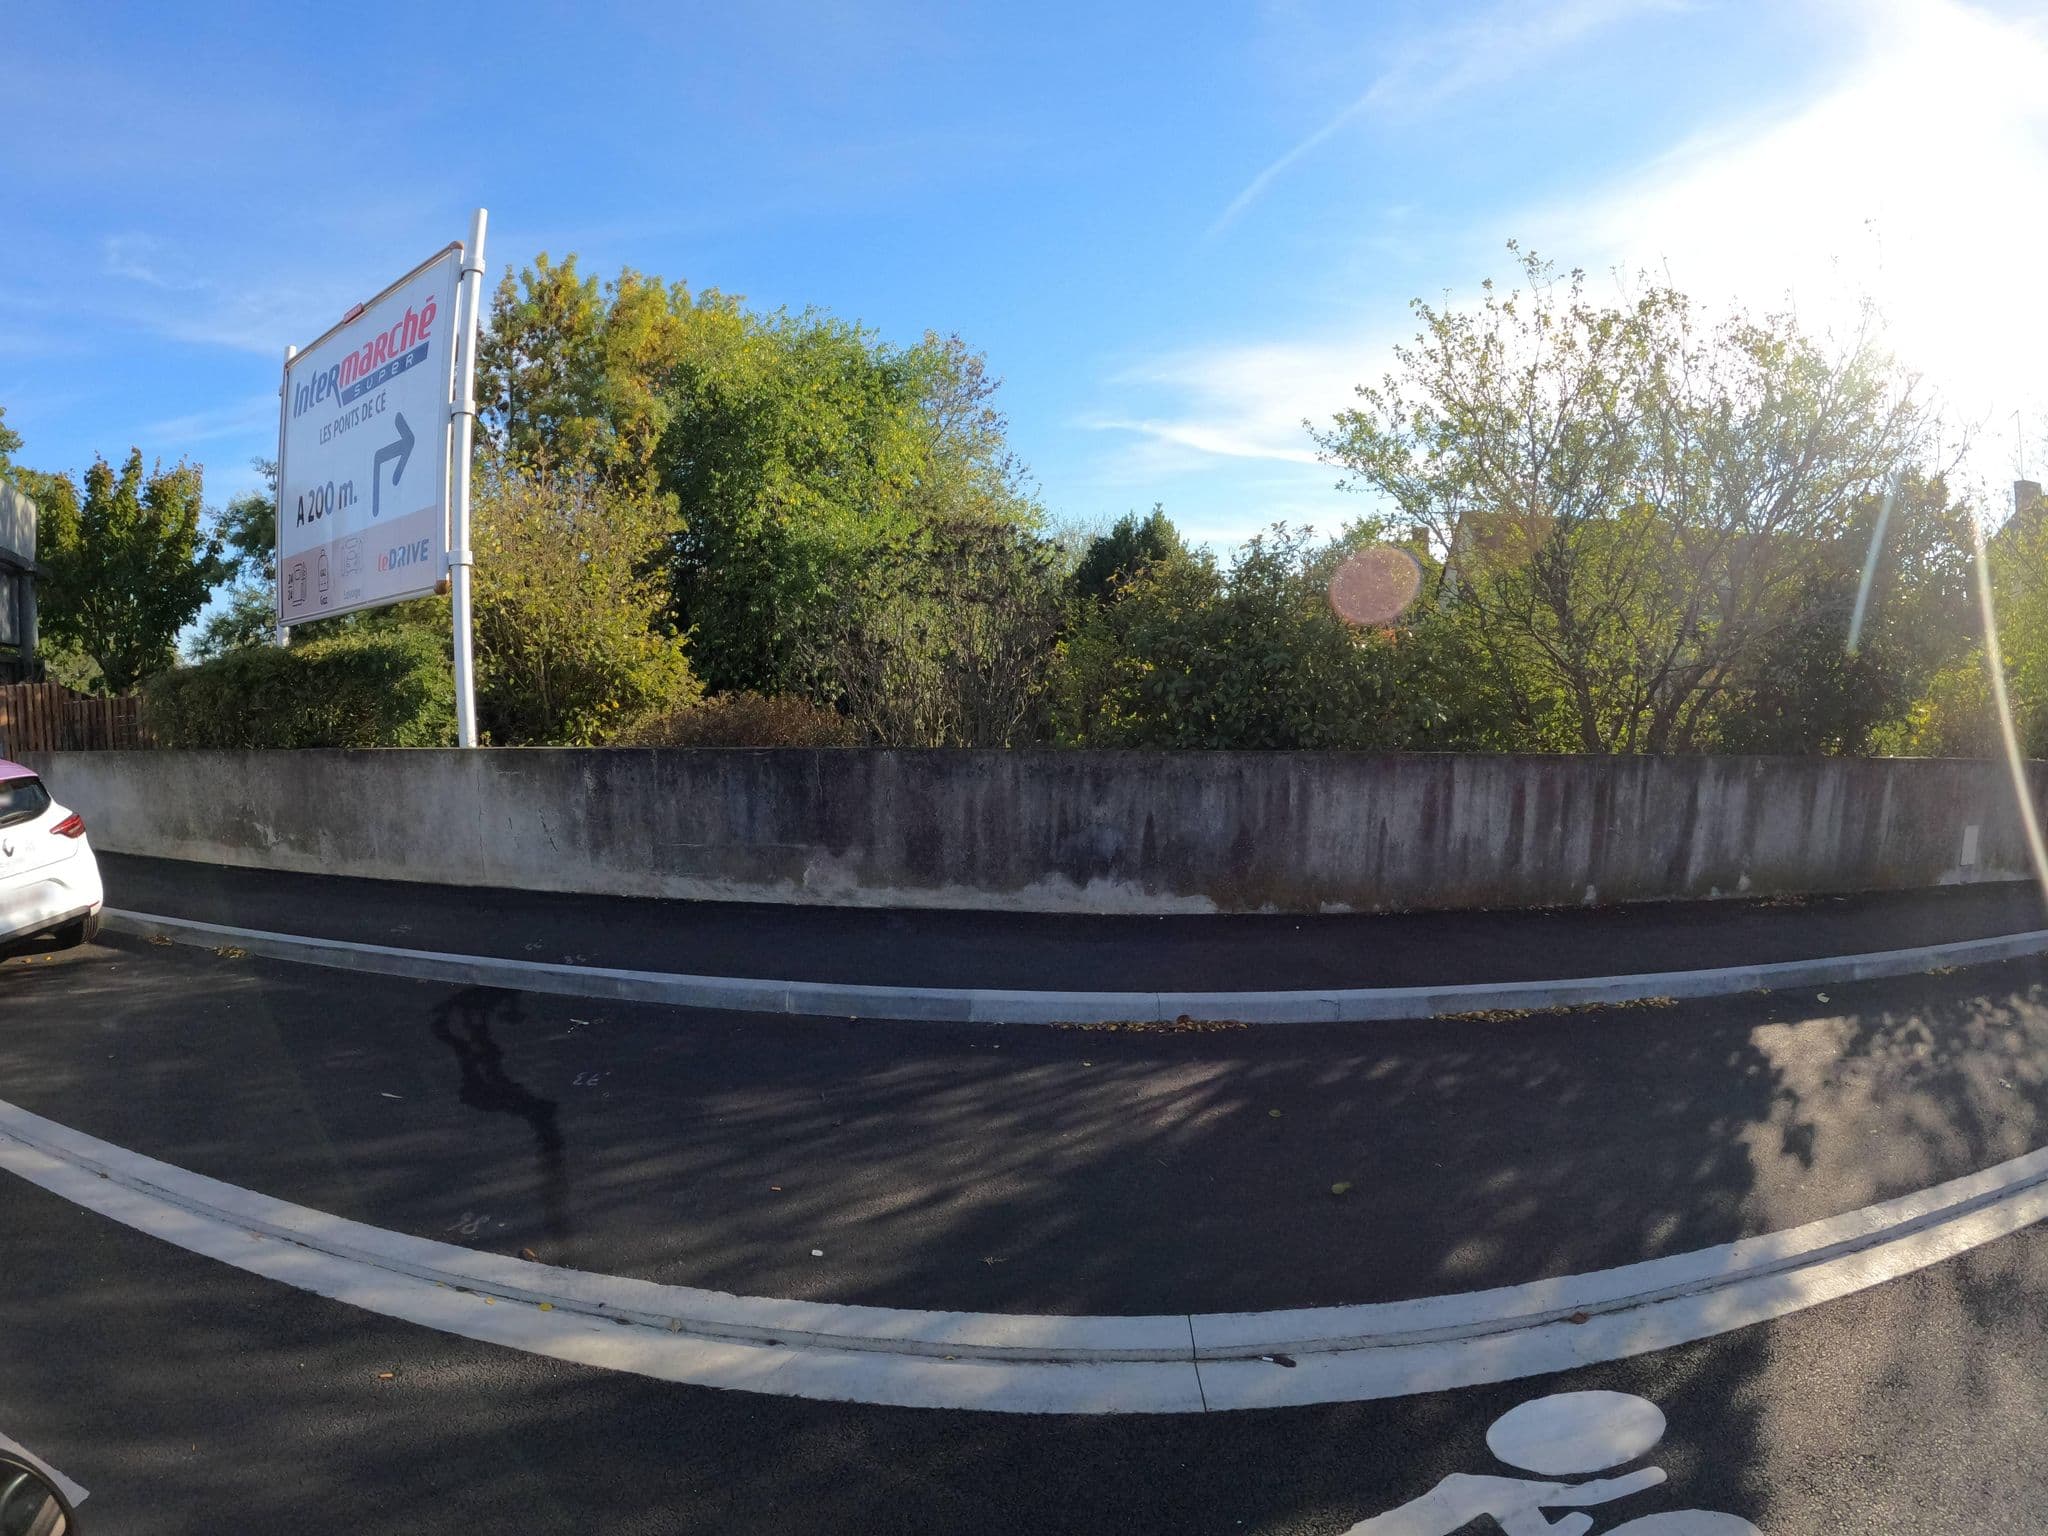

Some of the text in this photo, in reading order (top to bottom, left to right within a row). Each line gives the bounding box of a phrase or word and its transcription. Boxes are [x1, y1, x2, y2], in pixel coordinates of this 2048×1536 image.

[320, 423, 332, 445] LES
[333, 408, 360, 437] PONTS
[362, 399, 373, 421] DE
[297, 496, 305, 528] A
[308, 481, 334, 523] 200
